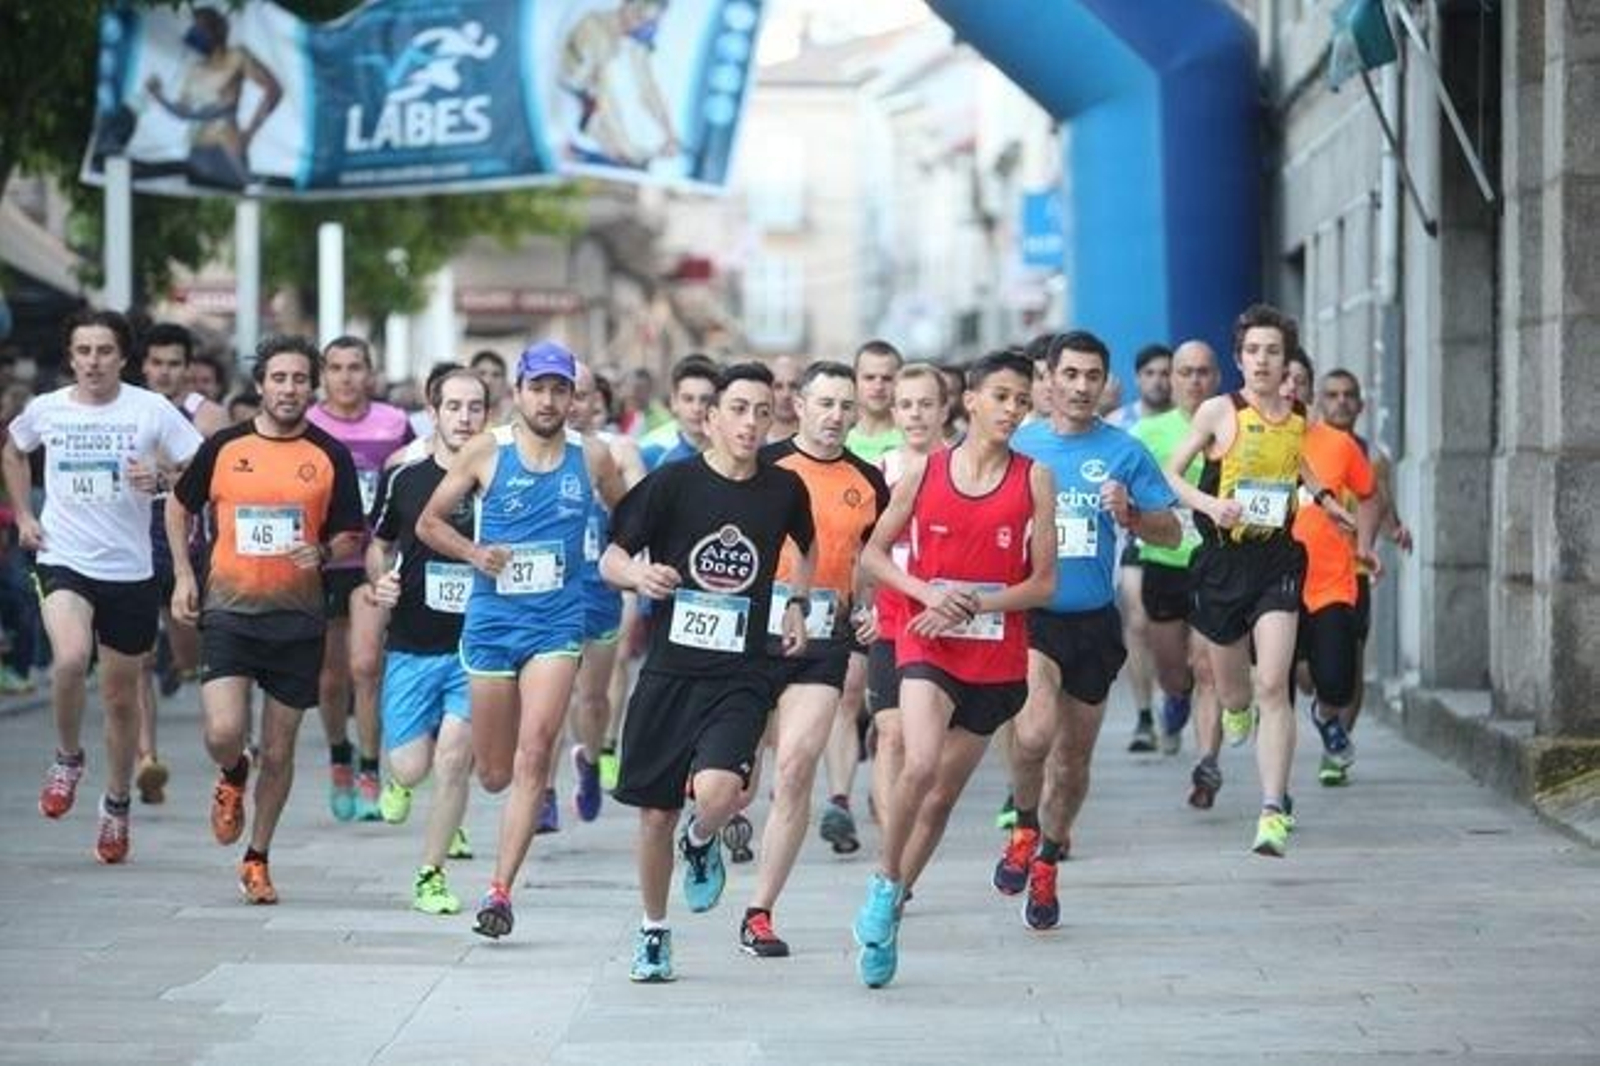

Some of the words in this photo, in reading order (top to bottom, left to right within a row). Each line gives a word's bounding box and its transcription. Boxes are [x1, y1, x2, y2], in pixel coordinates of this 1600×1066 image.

[346, 94, 492, 151] LABES
[72, 477, 93, 494] 141
[1249, 496, 1270, 515] 43
[251, 525, 273, 544] 46
[700, 545, 750, 562] Area
[512, 563, 534, 582] 37
[699, 559, 749, 577] Doce
[440, 582, 465, 602] 132
[683, 610, 720, 637] 257
